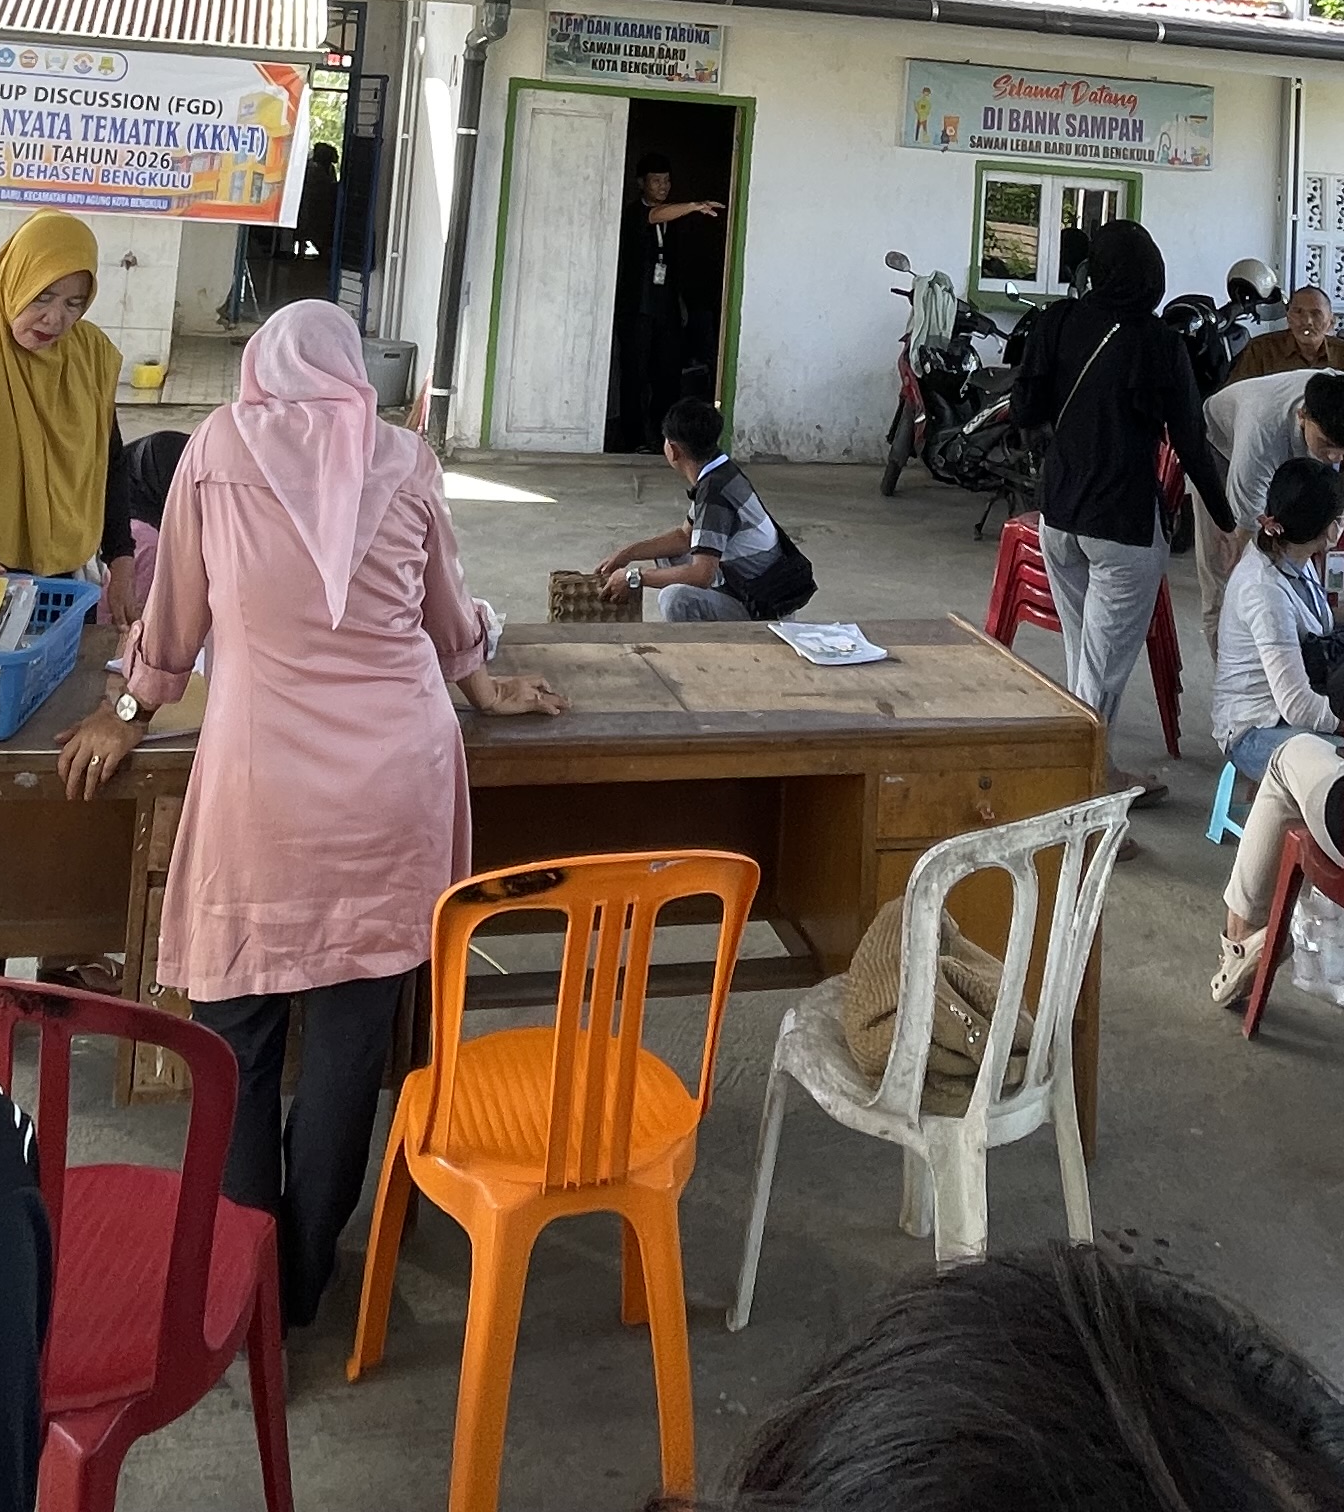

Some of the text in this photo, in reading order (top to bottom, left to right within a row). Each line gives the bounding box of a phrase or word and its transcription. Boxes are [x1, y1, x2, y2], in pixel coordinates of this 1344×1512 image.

[559, 17, 710, 45] LPM DAN KARANG TARUNA
[582, 40, 686, 62] SAWAH LEBAR BARU
[591, 58, 676, 77] KOTA BENGKULU
[33, 86, 160, 112] DISCUSSION
[168, 95, 223, 119] (FGD)
[992, 74, 1138, 117] Selamat Datang
[0, 107, 72, 141] NYATA
[80, 113, 181, 148] TEMATIK
[186, 122, 267, 158] (KKN-T)
[982, 106, 1144, 143] DI BANK SAMPAH
[12, 141, 44, 161] VIII
[52, 144, 118, 166] TAHUN
[124, 150, 171, 170] 2026
[969, 134, 1155, 162] SAWAH LEBAR BARU KOTA BENGKULU
[12, 162, 94, 183] DEHASEN
[101, 169, 192, 189] BENGKULU
